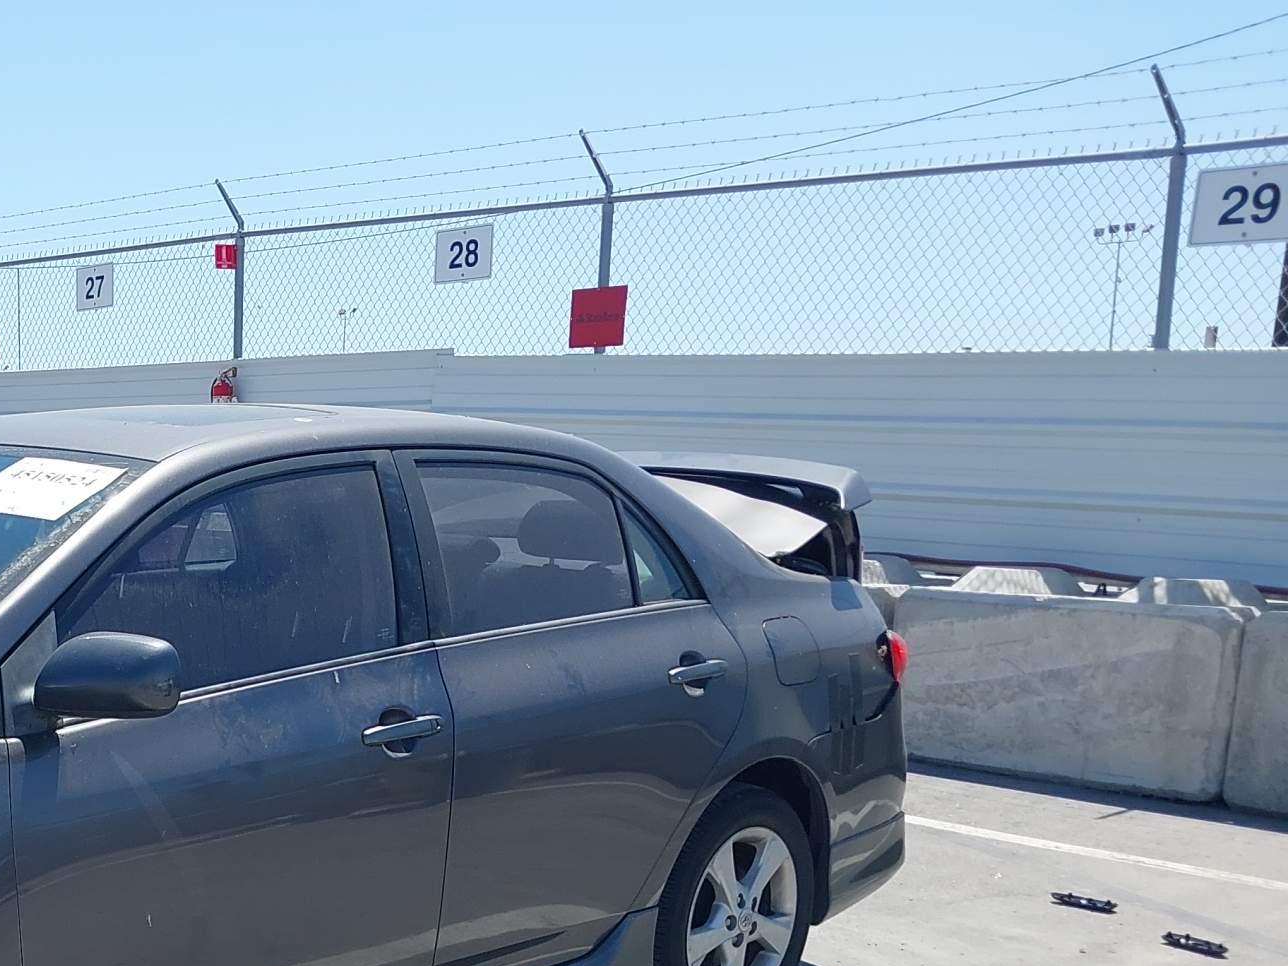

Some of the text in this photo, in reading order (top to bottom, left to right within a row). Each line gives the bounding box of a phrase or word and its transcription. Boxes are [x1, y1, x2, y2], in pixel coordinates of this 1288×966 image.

[1218, 182, 1281, 226] 29
[448, 238, 479, 269] 28
[85, 275, 105, 300] 27
